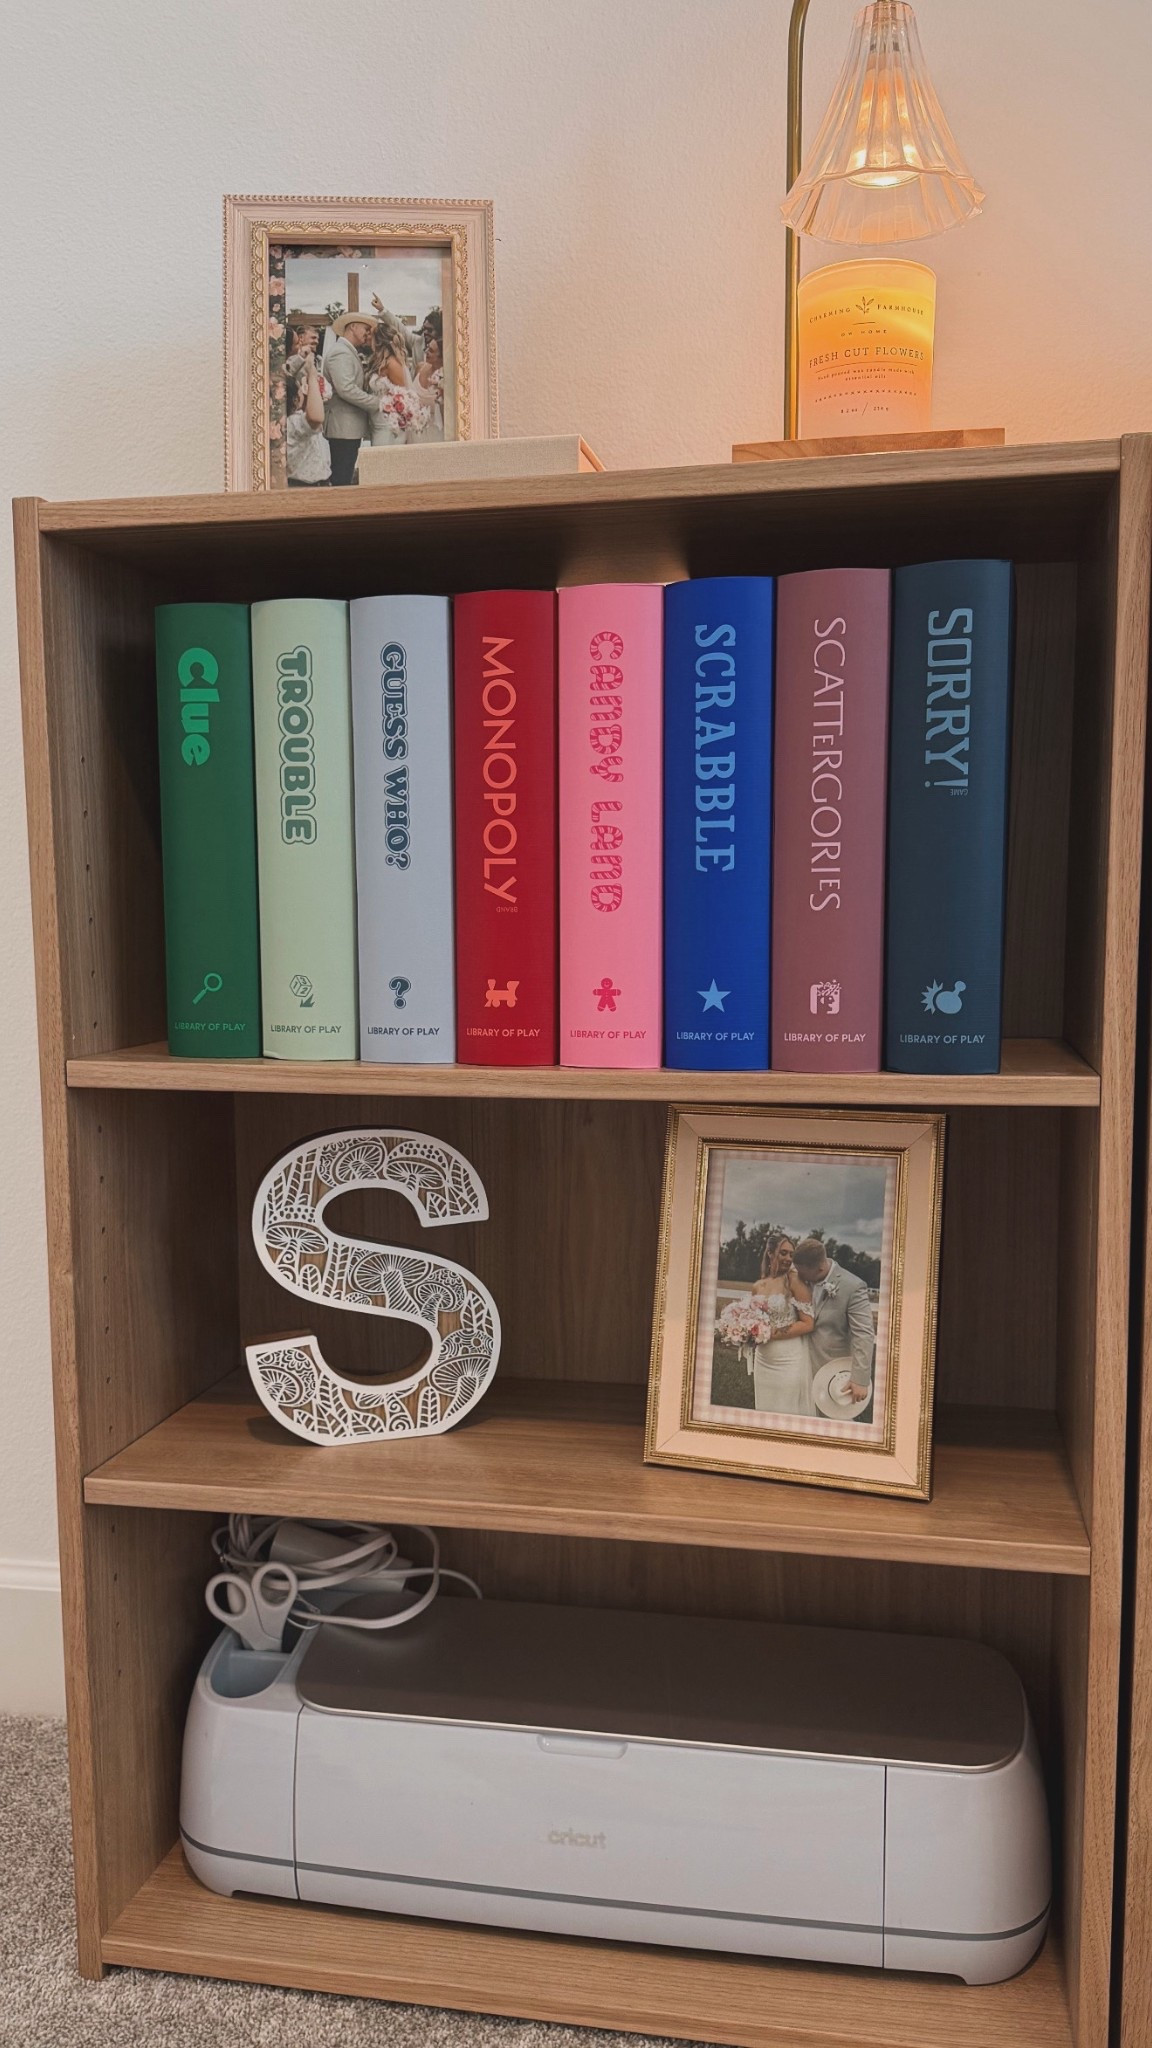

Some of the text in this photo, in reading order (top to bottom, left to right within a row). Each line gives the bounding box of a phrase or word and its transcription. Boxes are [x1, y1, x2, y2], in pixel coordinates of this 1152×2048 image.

[809, 303, 924, 323] CHARMING FARMHOUSE
[809, 346, 924, 369] FRESH CUT FLOWERS
[177, 647, 220, 766] Clue
[924, 607, 973, 788] SORRY!
[276, 645, 317, 845] TROUBLE
[380, 641, 411, 871] GUESS WHO?
[695, 624, 736, 873] SCRABBLE
[482, 636, 518, 904] MONOPOLY
[809, 617, 847, 911] SCATTERGORIES
[174, 1022, 246, 1031] LIBRARY OF PLAY
[270, 1025, 342, 1034] LIBRARY OF PLAY
[367, 1027, 440, 1036] LIBRARY OF PLAY
[466, 1028, 541, 1037] LIBRARY OF PLAY
[570, 1030, 647, 1039] LIBRARY OF PLAY
[676, 1032, 755, 1041] LIBRARY OF PLAY
[784, 1033, 867, 1042] LIBRARY OF PLAY
[899, 1034, 986, 1044] LIBRARY OF PLAY
[245, 1128, 502, 1447] S
[547, 1827, 607, 1850] cricut
